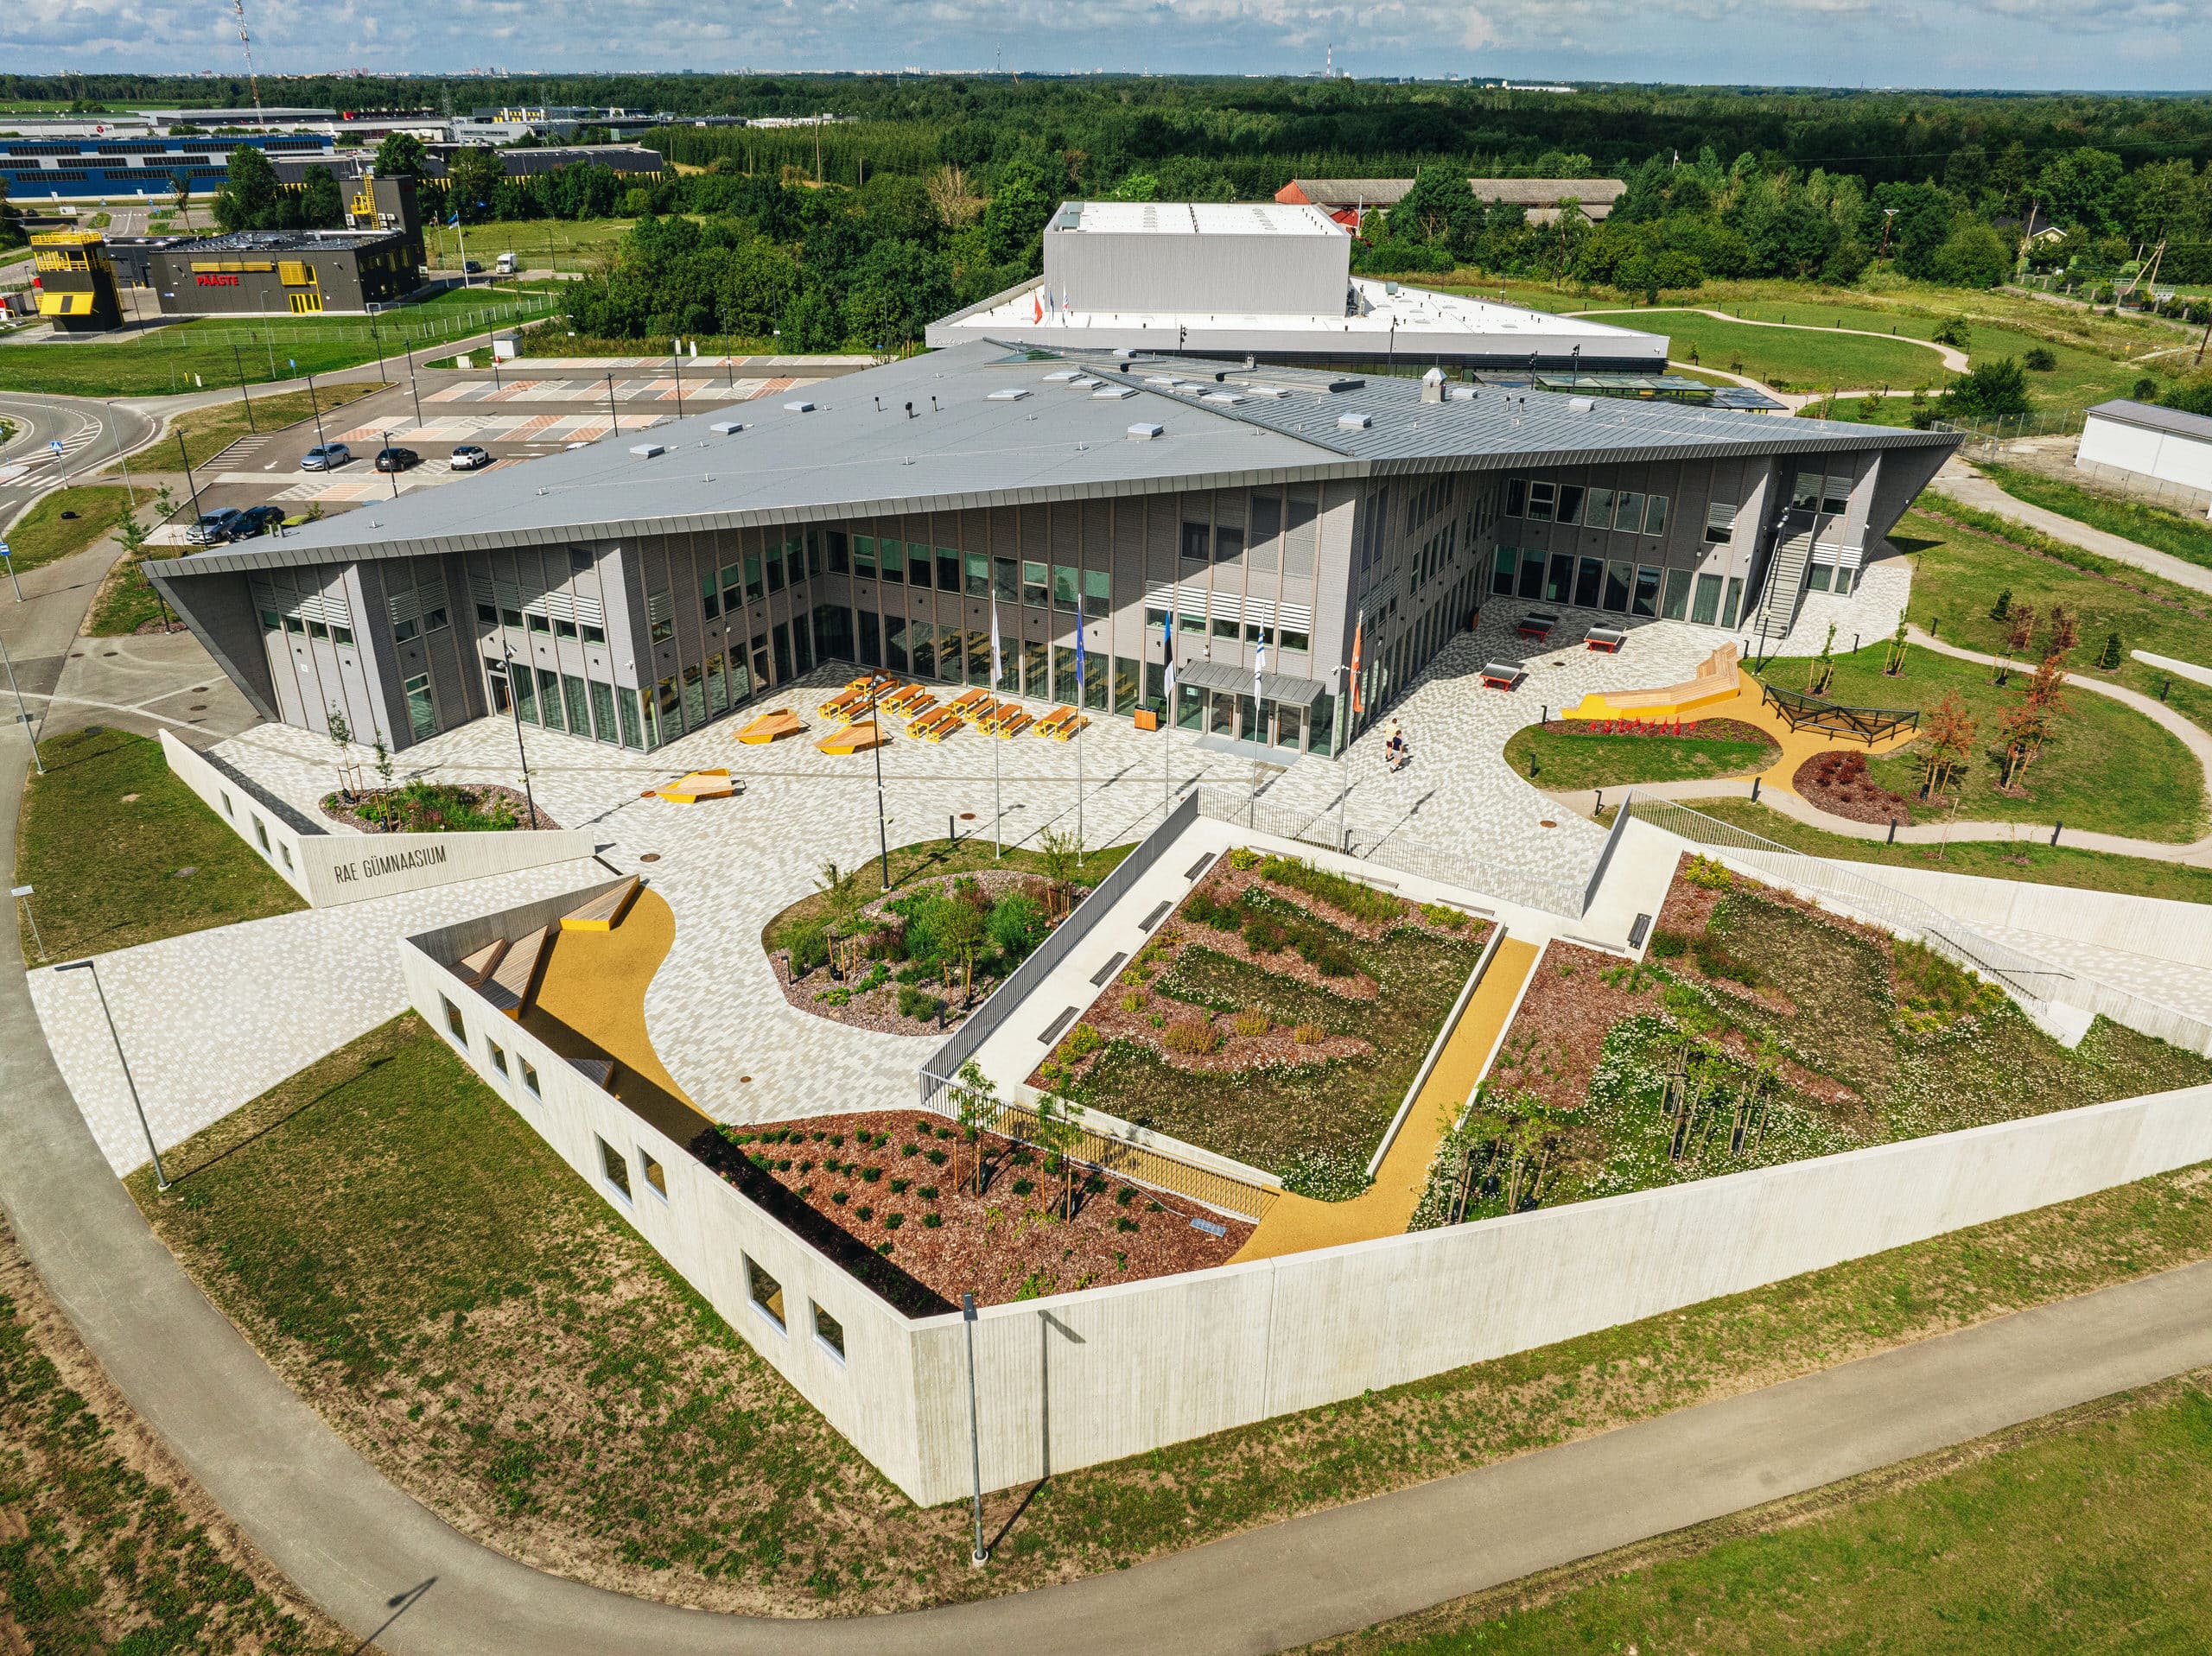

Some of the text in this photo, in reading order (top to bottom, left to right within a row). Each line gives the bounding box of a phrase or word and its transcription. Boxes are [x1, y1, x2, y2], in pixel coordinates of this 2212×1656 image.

[196, 275, 238, 286] PÄÄSTE
[334, 845, 447, 884] RAE GÜMNAASIUM
